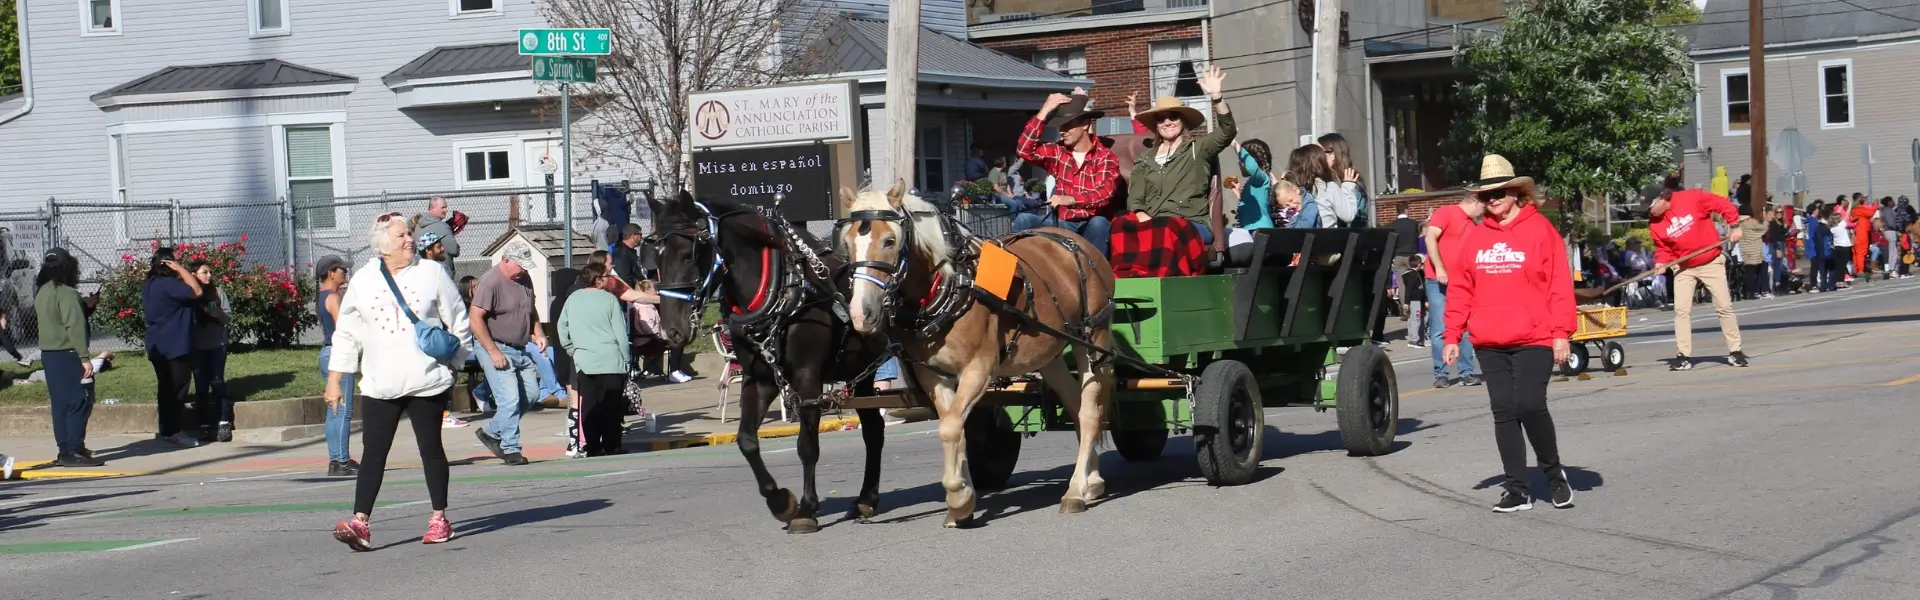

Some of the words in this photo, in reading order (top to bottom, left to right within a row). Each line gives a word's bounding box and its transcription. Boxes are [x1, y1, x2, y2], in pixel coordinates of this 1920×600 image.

[547, 32, 567, 51] 8th
[573, 32, 586, 51] St
[549, 58, 573, 80] Spring
[576, 60, 584, 78] St
[734, 99, 754, 111] ST.
[760, 95, 801, 110] MARY
[805, 93, 817, 106] of
[820, 92, 838, 104] the
[734, 108, 838, 125] ANNUNCIATION
[735, 123, 794, 138] CATHOLIC
[799, 120, 839, 134] PARISH
[698, 161, 736, 175] Misa
[741, 162, 757, 172] en
[762, 155, 822, 171] español
[730, 182, 793, 195] domingo
[1475, 248, 1525, 264] Marks
